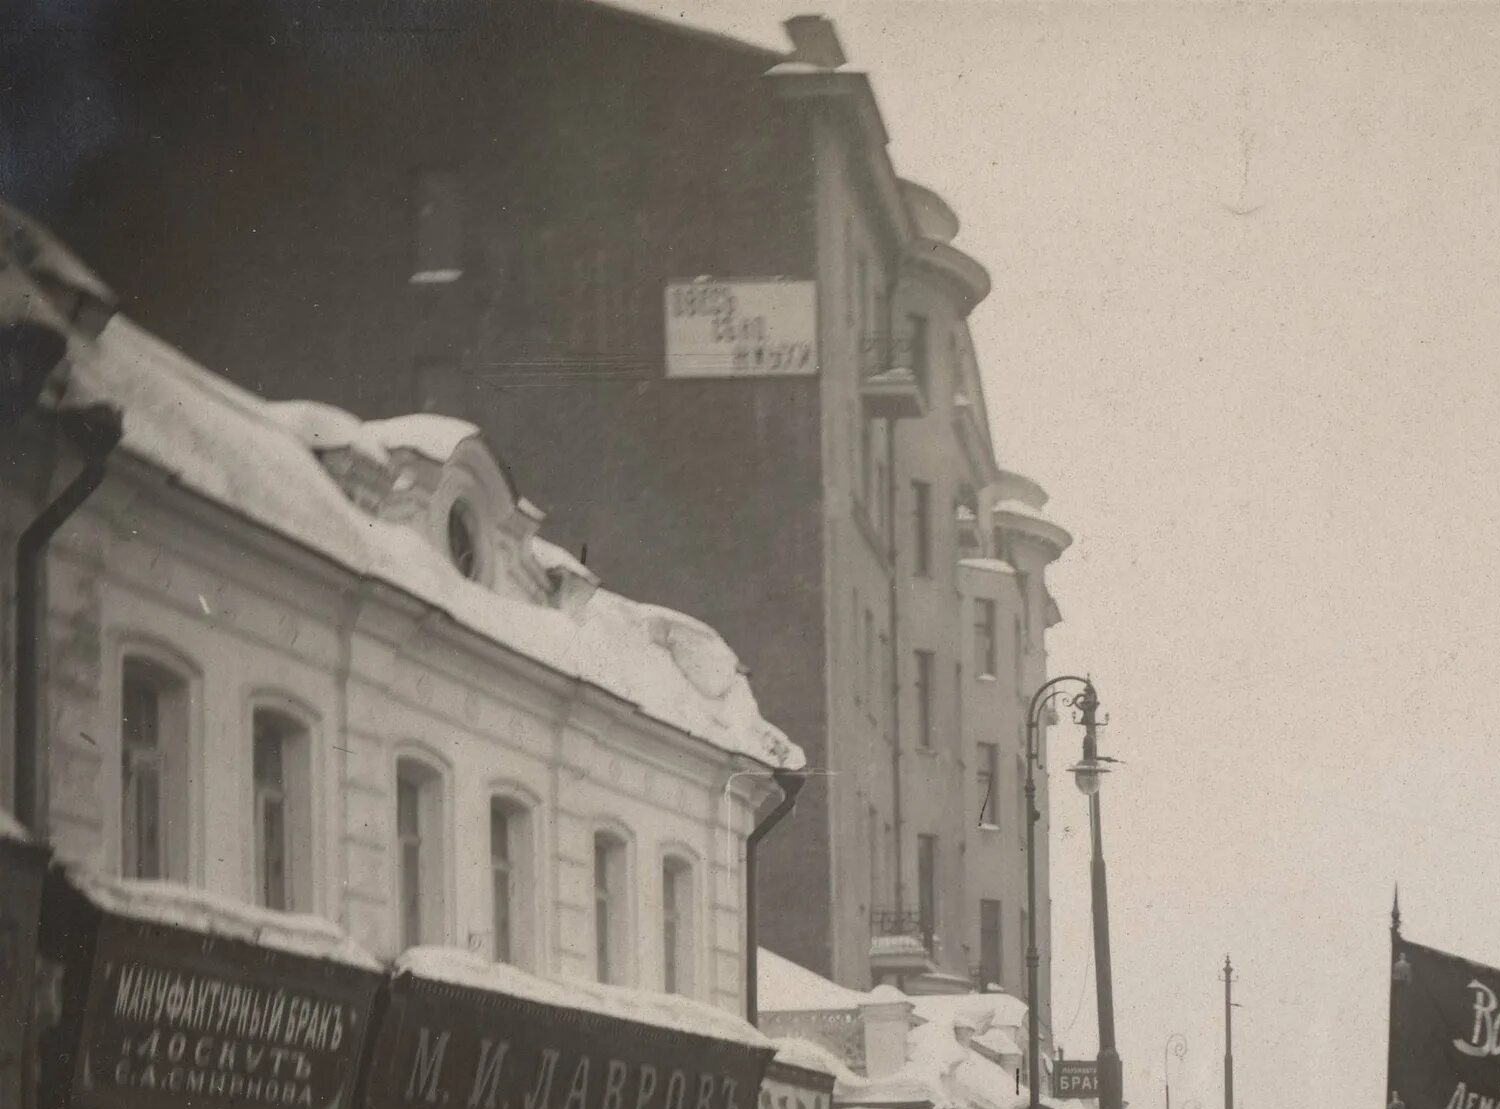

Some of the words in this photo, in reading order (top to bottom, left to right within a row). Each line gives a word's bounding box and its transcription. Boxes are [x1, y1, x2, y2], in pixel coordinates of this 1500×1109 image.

[114, 962, 287, 1043] МАНУФАКТУРНЫЙ
[284, 994, 344, 1053] БРАКЪ
[404, 1026, 450, 1104] М.
